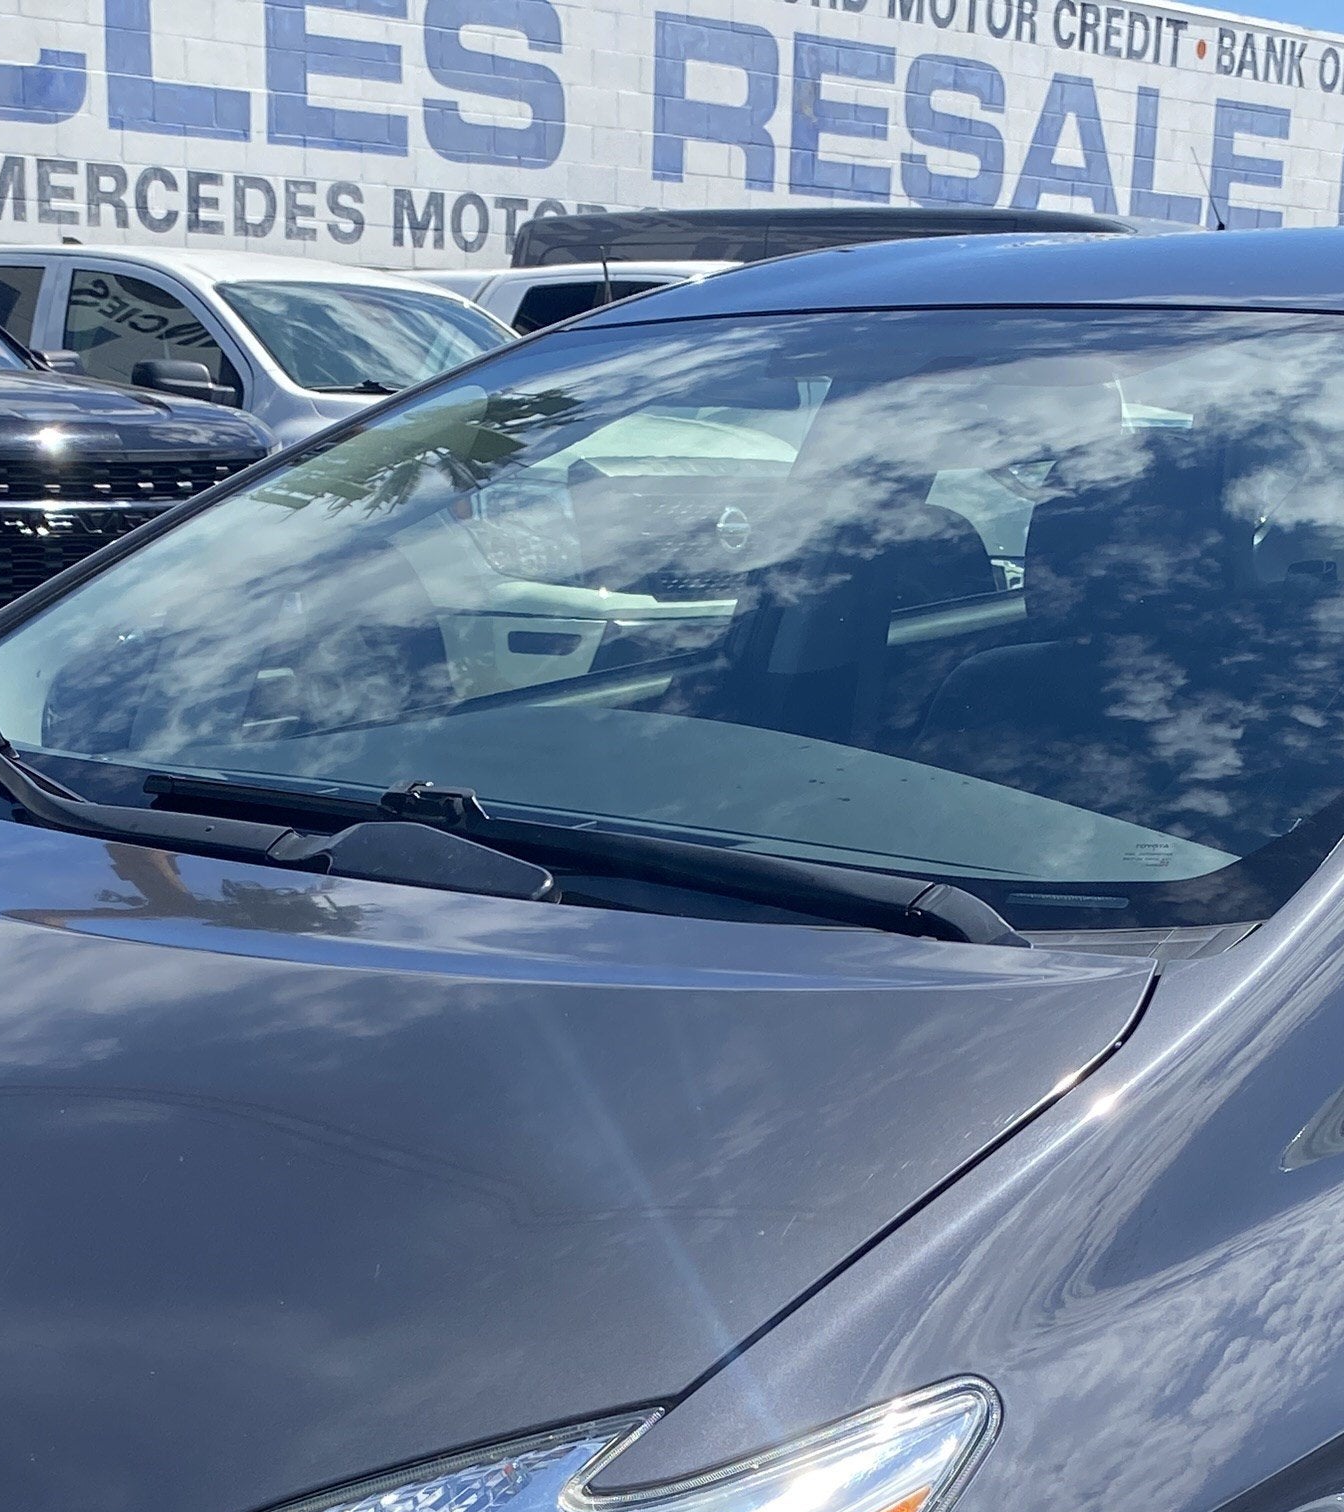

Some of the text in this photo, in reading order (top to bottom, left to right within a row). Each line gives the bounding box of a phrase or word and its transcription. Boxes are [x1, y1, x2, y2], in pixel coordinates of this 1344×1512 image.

[1053, 0, 1188, 68] CREDIT
[1217, 27, 1308, 88] BANK
[652, 10, 1290, 230] RESALE
[393, 187, 609, 254] MOT
